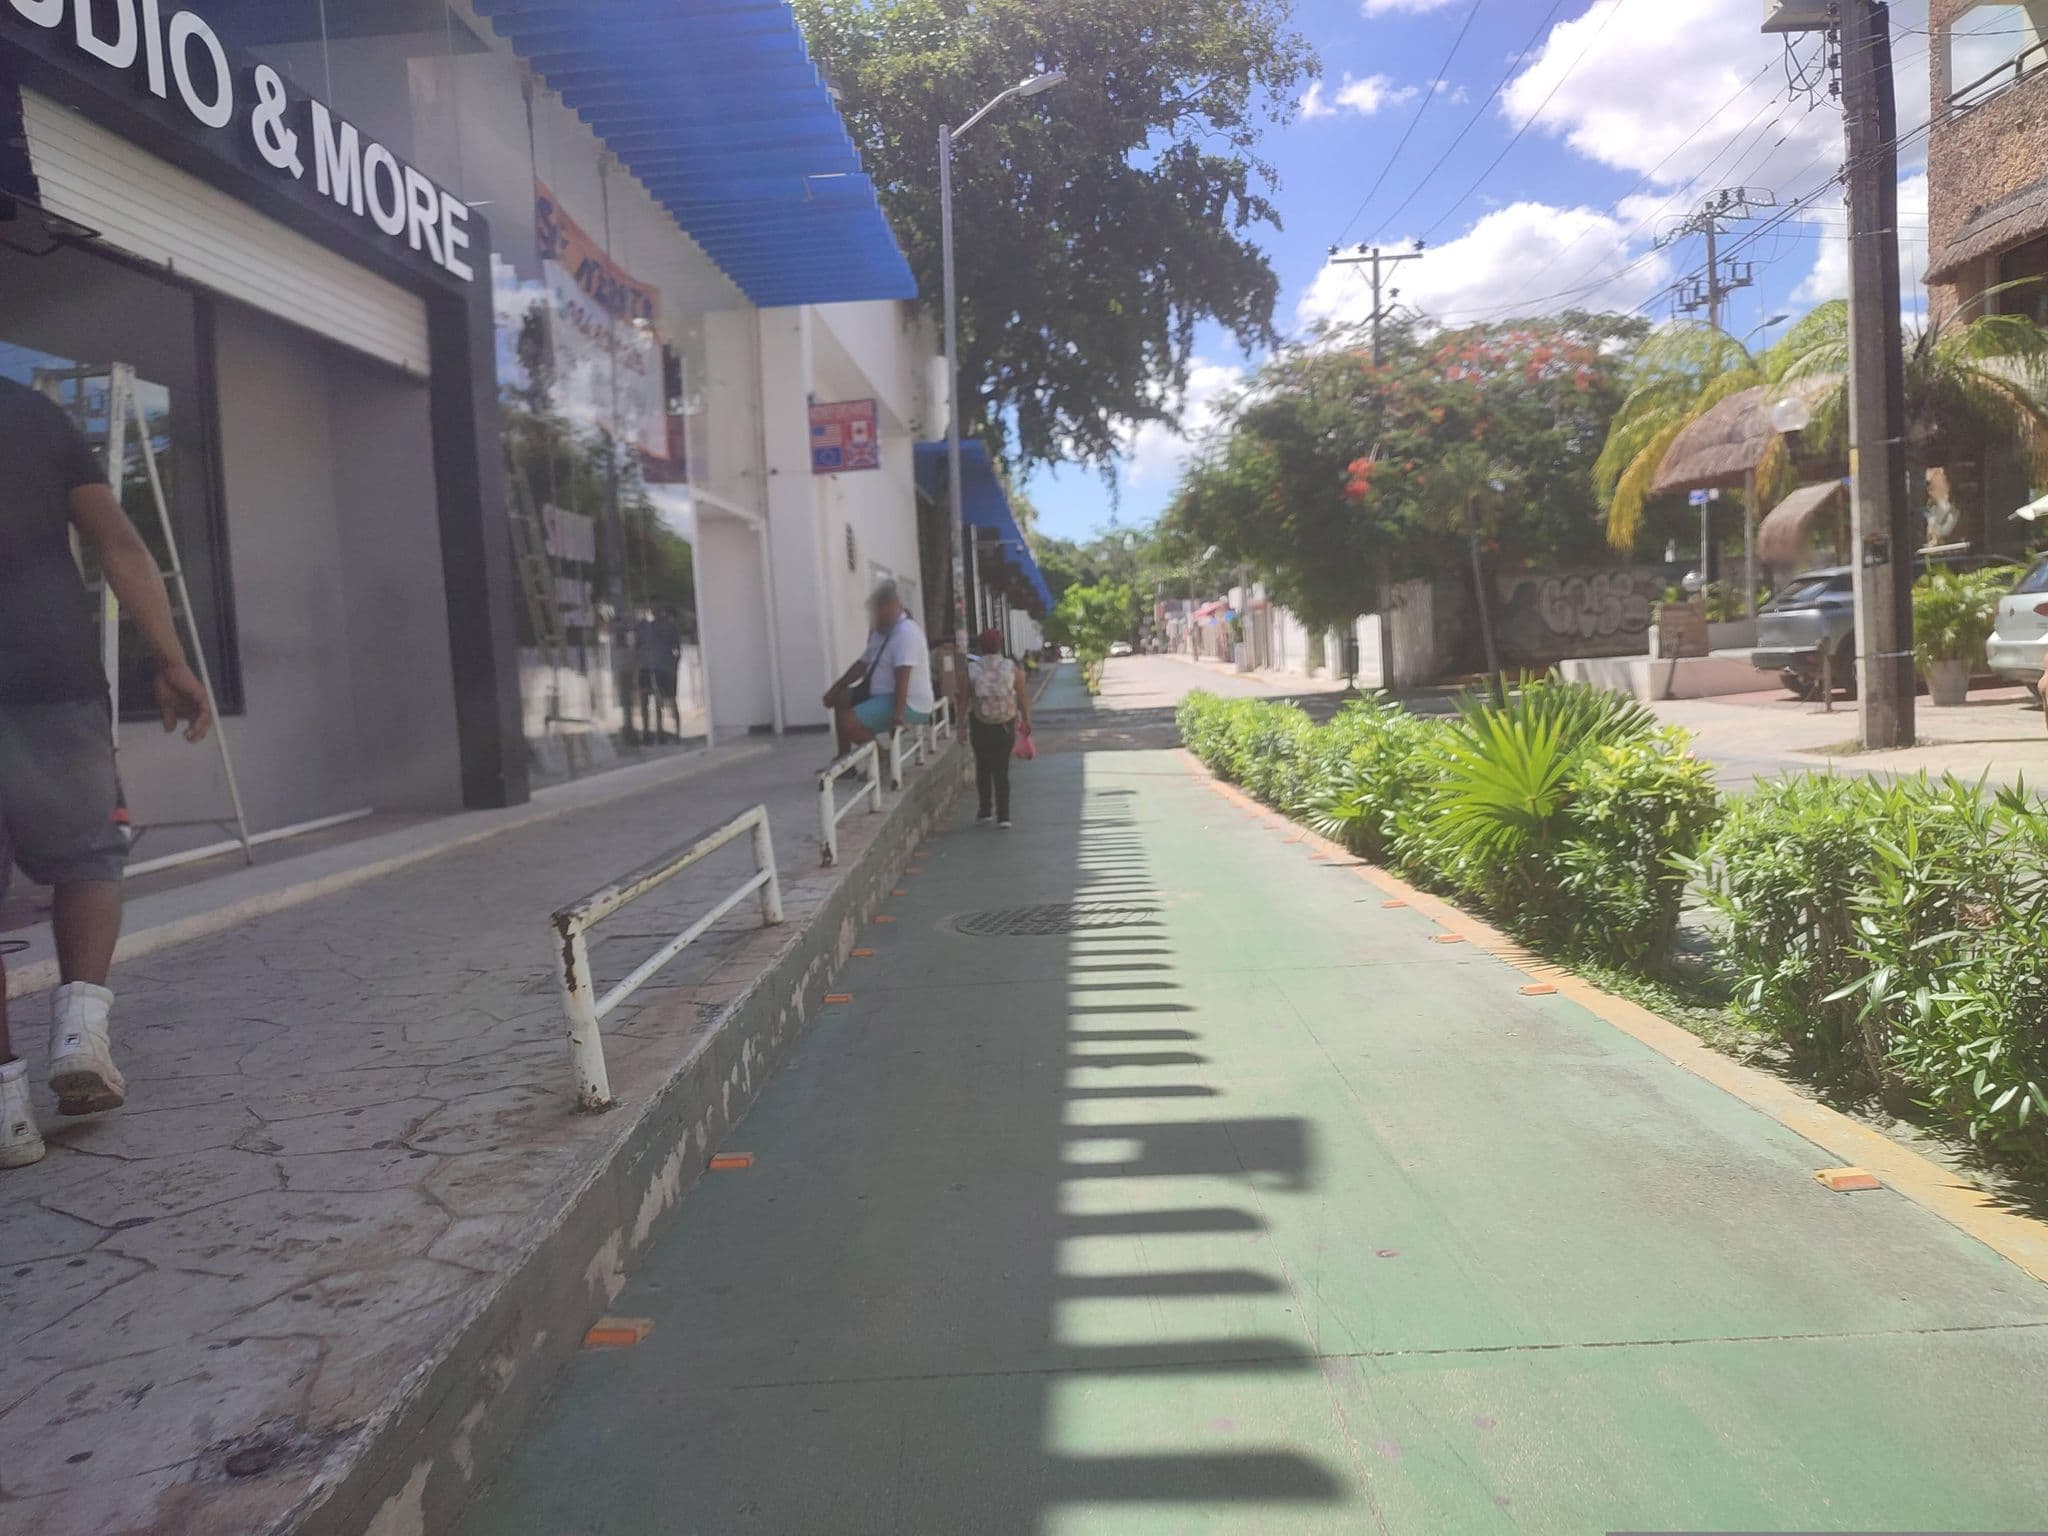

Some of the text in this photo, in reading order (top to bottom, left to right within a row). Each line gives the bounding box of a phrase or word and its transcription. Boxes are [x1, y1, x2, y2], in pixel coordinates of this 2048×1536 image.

[8, 0, 233, 128] DIO
[251, 64, 304, 179] &
[311, 99, 474, 282] MORE
